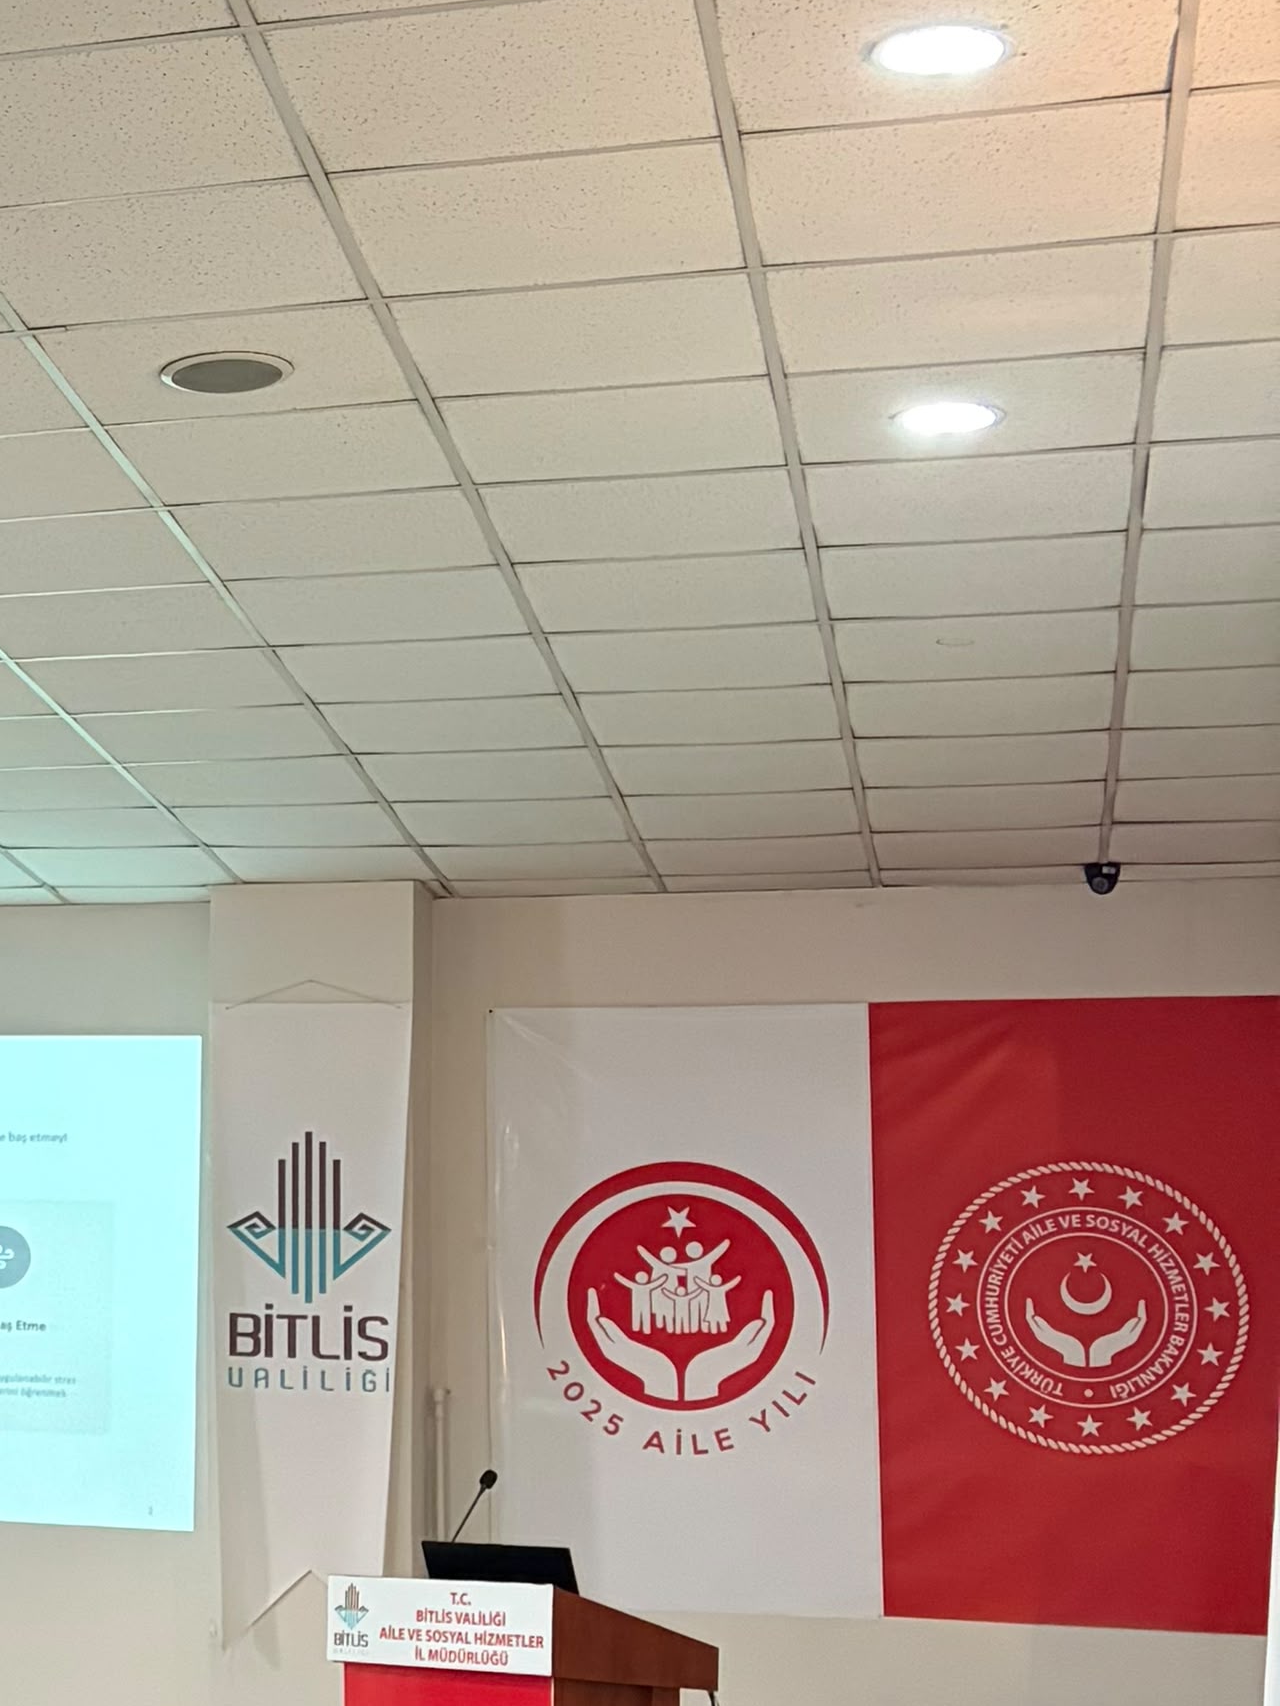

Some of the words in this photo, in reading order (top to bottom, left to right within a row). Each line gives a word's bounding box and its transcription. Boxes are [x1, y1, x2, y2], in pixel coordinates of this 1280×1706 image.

[1022, 1218, 1057, 1244] AİLE
[1058, 1214, 1081, 1228] VE
[1085, 1214, 1147, 1248] SOSYAL
[985, 1237, 1023, 1346] CUMHURİYETİ
[1147, 1243, 1190, 1337] HİZMETLER
[16, 1320, 47, 1331] Etme
[229, 1303, 389, 1362] BİTLİS
[1001, 1346, 1063, 1396] TÜRKİYE
[1110, 1335, 1185, 1399] BAKANLIĞI
[546, 1360, 624, 1436] 2025
[642, 1428, 735, 1456] AİLE
[748, 1371, 816, 1433] YILI
[450, 1592, 471, 1606] T.C.
[416, 1607, 452, 1624] BİTLİS
[455, 1610, 506, 1627] VALİLİĞİ
[334, 1630, 369, 1647] BİTLİS
[379, 1625, 405, 1641] AİLE
[407, 1628, 423, 1641] VE
[425, 1629, 471, 1645] SOSYAL
[474, 1631, 544, 1649] HİZMETLER
[415, 1645, 425, 1661] İL
[428, 1647, 509, 1666] MÜDÜRLÜĞÜ
